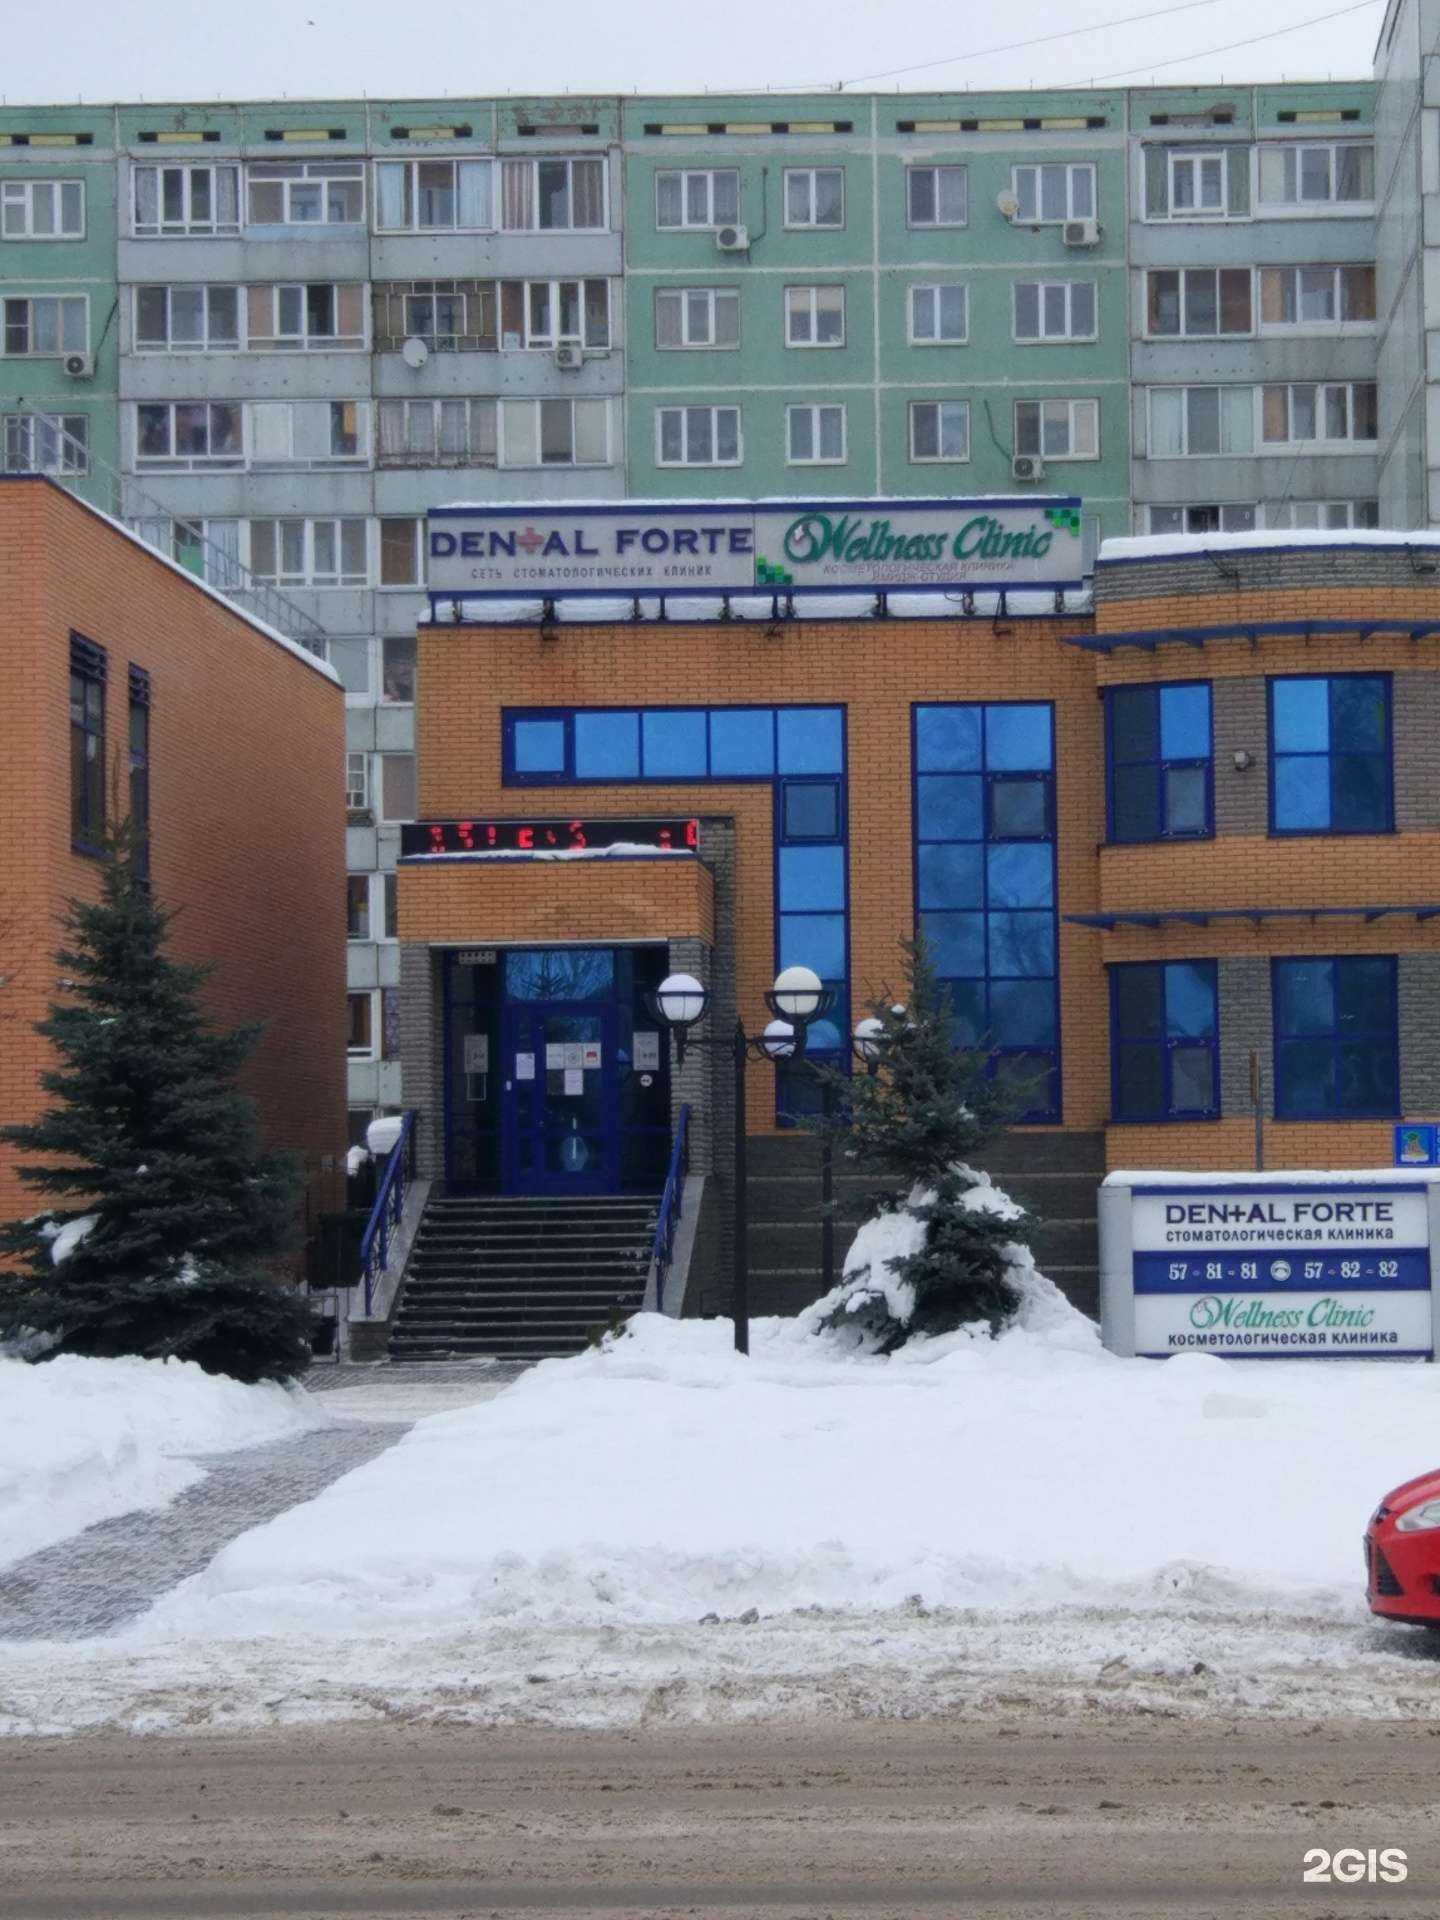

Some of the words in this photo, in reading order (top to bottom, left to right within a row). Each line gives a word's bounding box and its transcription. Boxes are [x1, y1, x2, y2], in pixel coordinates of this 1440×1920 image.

[616, 528, 754, 555] FORTE
[783, 512, 949, 563] Wellness
[952, 515, 1053, 560] Clinic
[471, 568, 502, 579] СЕТЬ
[664, 564, 713, 577] КЛИНИК
[1294, 1202, 1394, 1222] FORTE
[1166, 1228, 1322, 1242] стоматологическая
[1328, 1227, 1394, 1240] клиника
[1189, 1295, 1304, 1329] Wellness
[1307, 1298, 1375, 1328] Clinic
[1168, 1332, 1327, 1346] косметологическая
[1332, 1331, 1398, 1344] клиника
